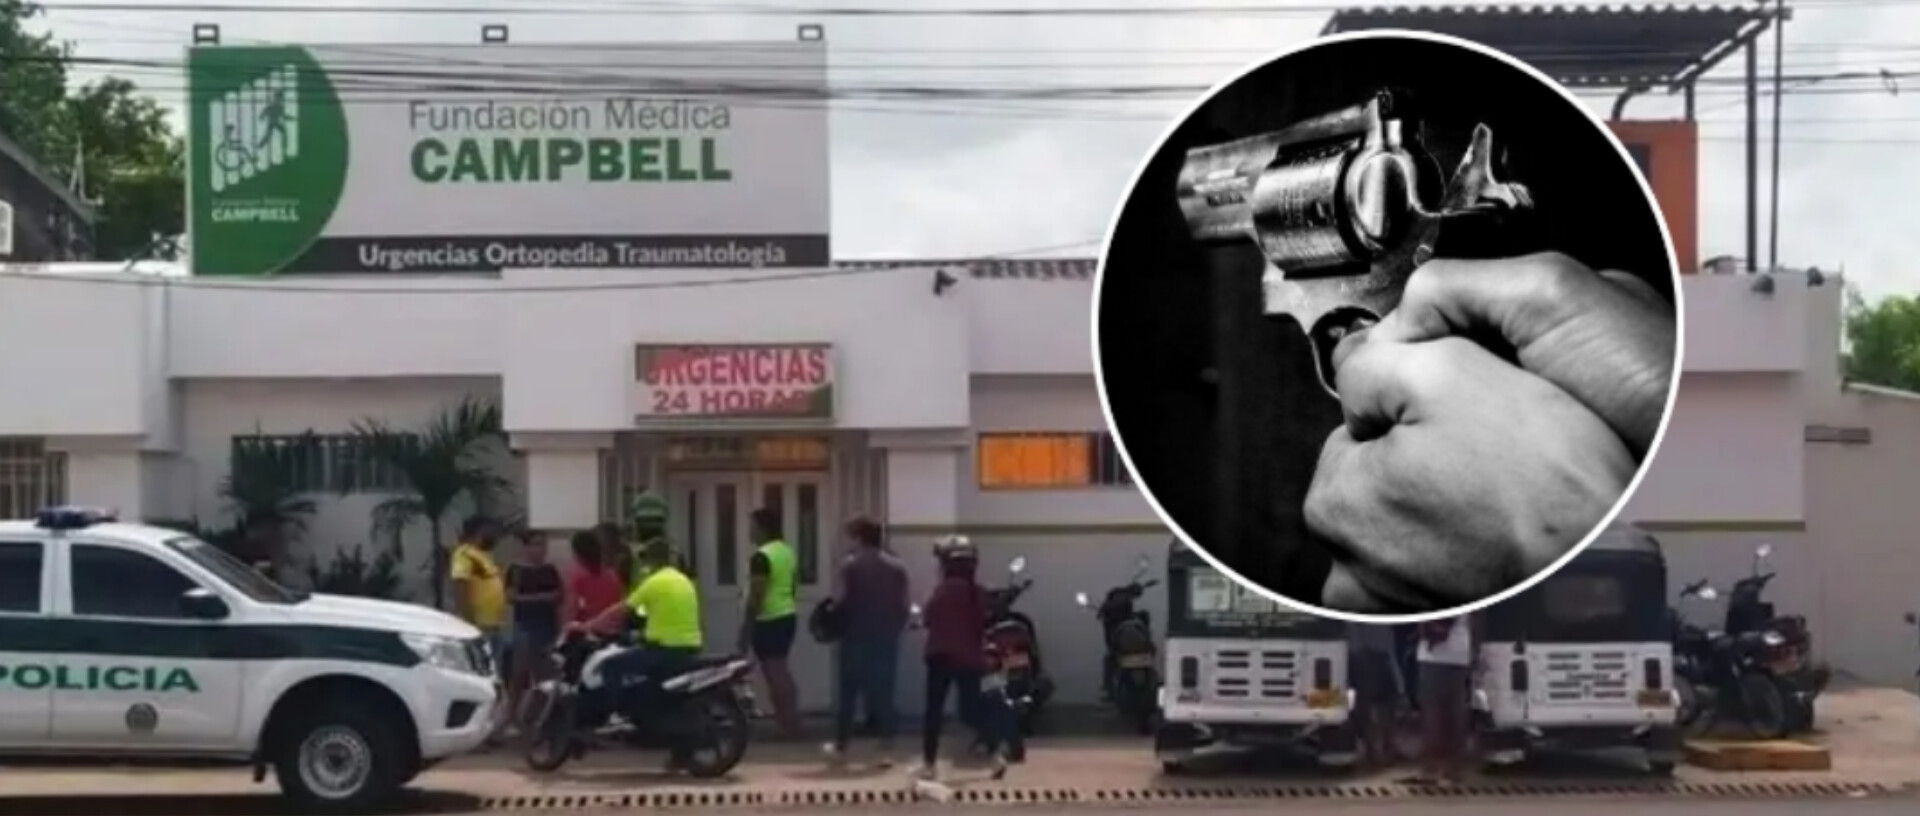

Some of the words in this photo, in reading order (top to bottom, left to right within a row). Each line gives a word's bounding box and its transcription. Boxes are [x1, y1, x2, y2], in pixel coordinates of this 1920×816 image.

[409, 97, 591, 131] Fundación
[604, 97, 732, 131] Médica
[410, 137, 732, 183] CAMPBELL
[211, 208, 300, 221] CAMPBELL
[359, 243, 479, 270] Urgencias
[485, 241, 609, 268] Ortopedia
[613, 241, 787, 268] Traumatología
[653, 390, 690, 413] 24
